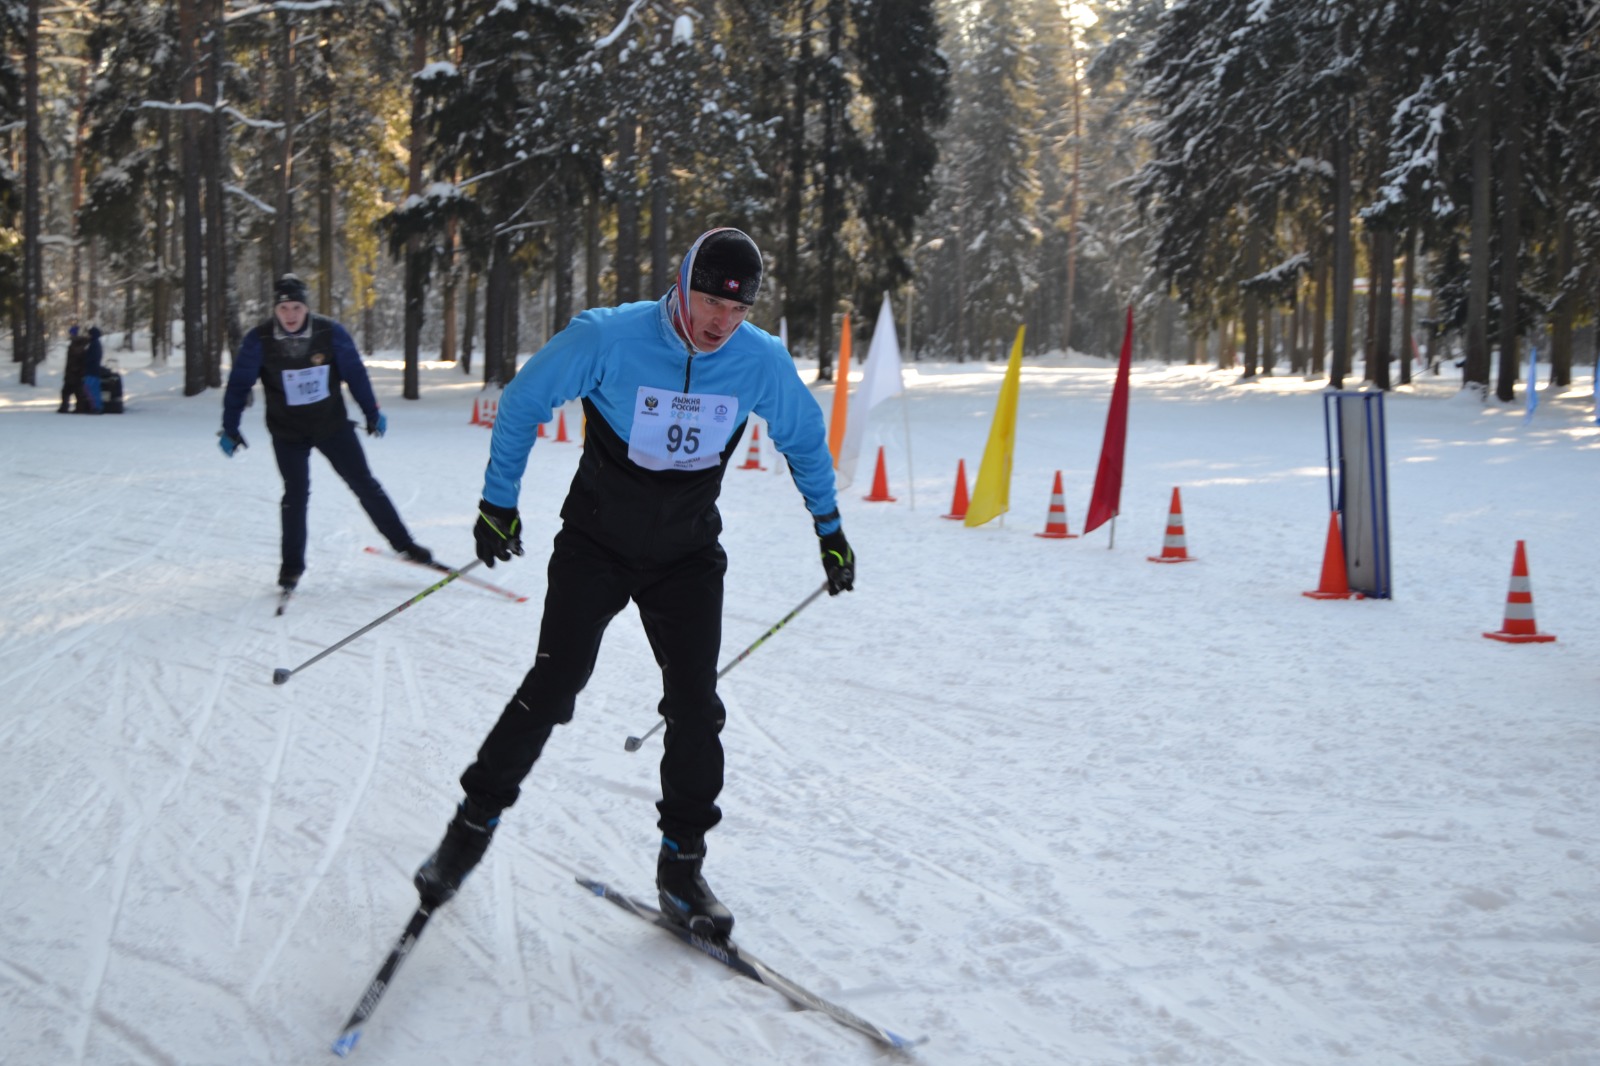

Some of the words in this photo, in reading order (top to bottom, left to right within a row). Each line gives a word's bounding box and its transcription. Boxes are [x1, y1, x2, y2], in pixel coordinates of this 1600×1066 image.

[671, 395, 701, 405] ЛЫЖНЯ
[671, 402, 700, 413] РОССИИ
[666, 424, 701, 455] 95
